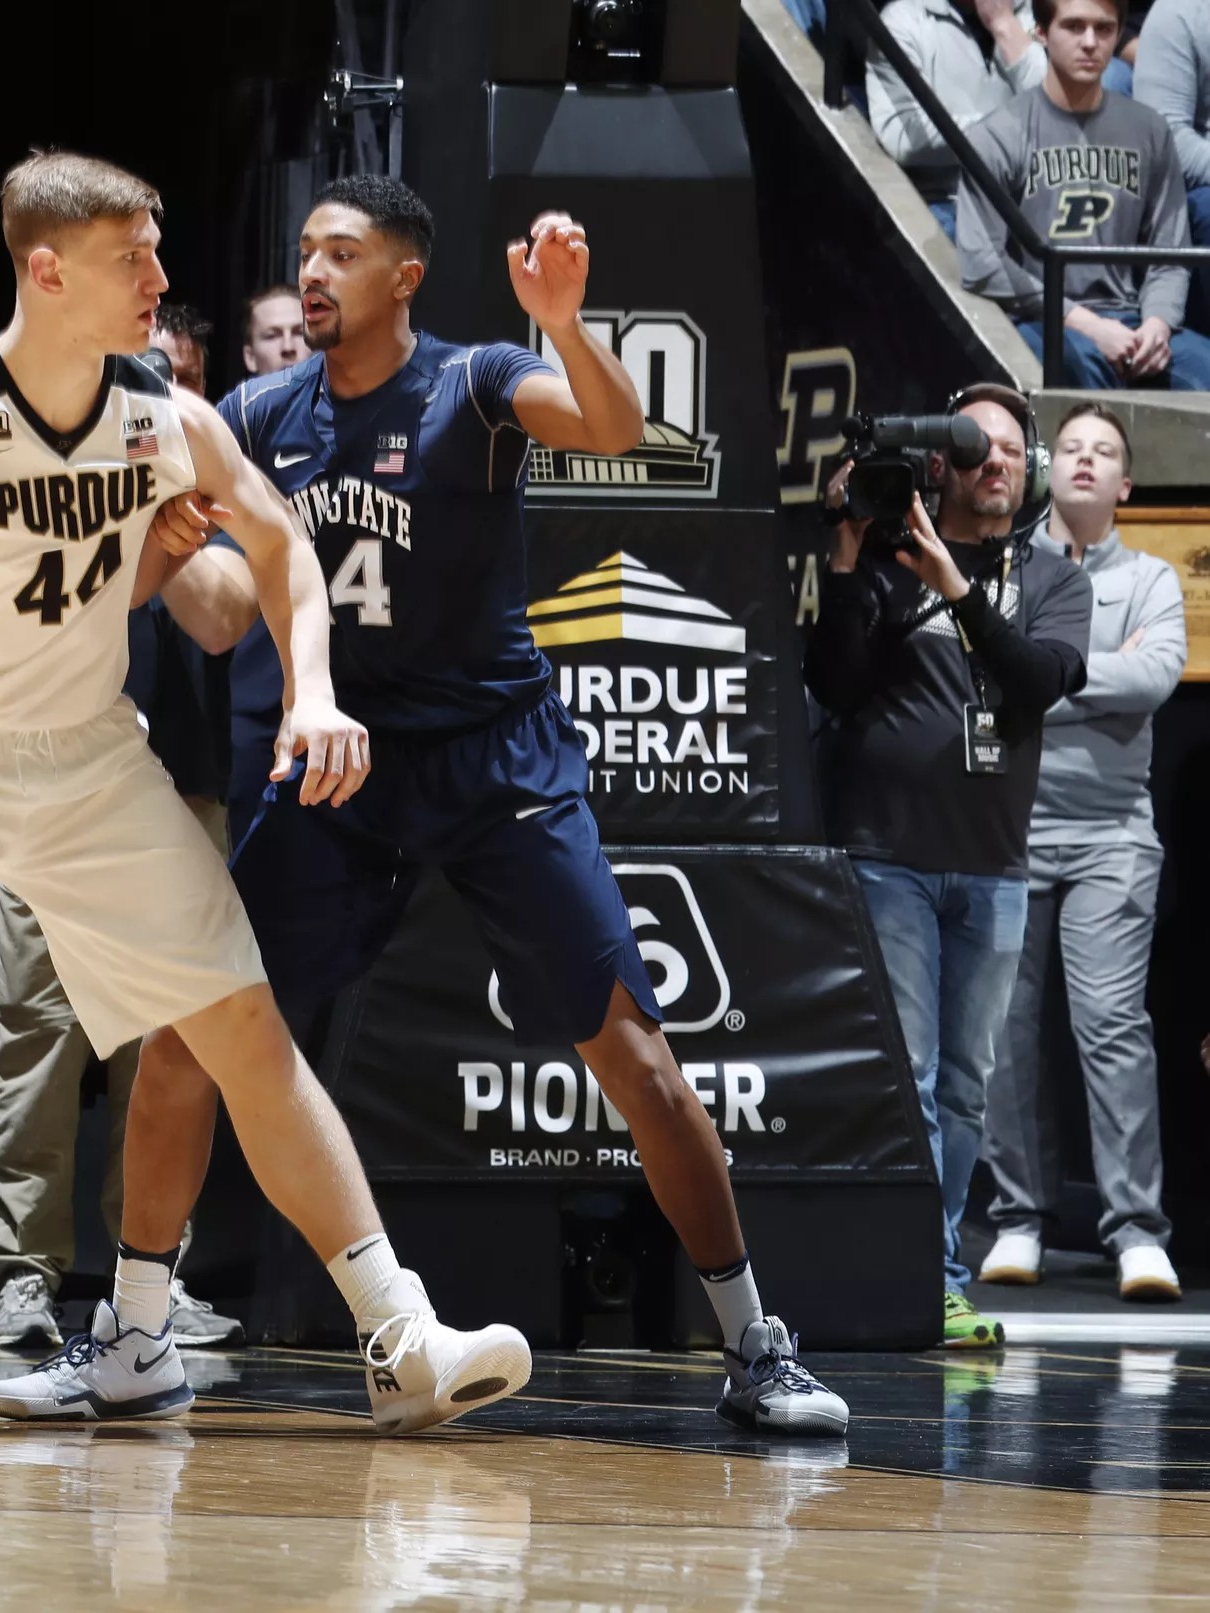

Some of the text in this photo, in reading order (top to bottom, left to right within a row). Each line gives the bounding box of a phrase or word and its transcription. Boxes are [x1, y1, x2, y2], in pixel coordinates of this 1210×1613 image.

[1025, 145, 1141, 199] PURDUE
[1049, 189, 1114, 239] P
[13, 529, 122, 627] 44
[559, 666, 748, 715] URDUE
[573, 719, 749, 765] DERAL
[635, 769, 749, 794] UNION
[458, 1062, 766, 1133] PIONER
[490, 1149, 580, 1167] BRAND
